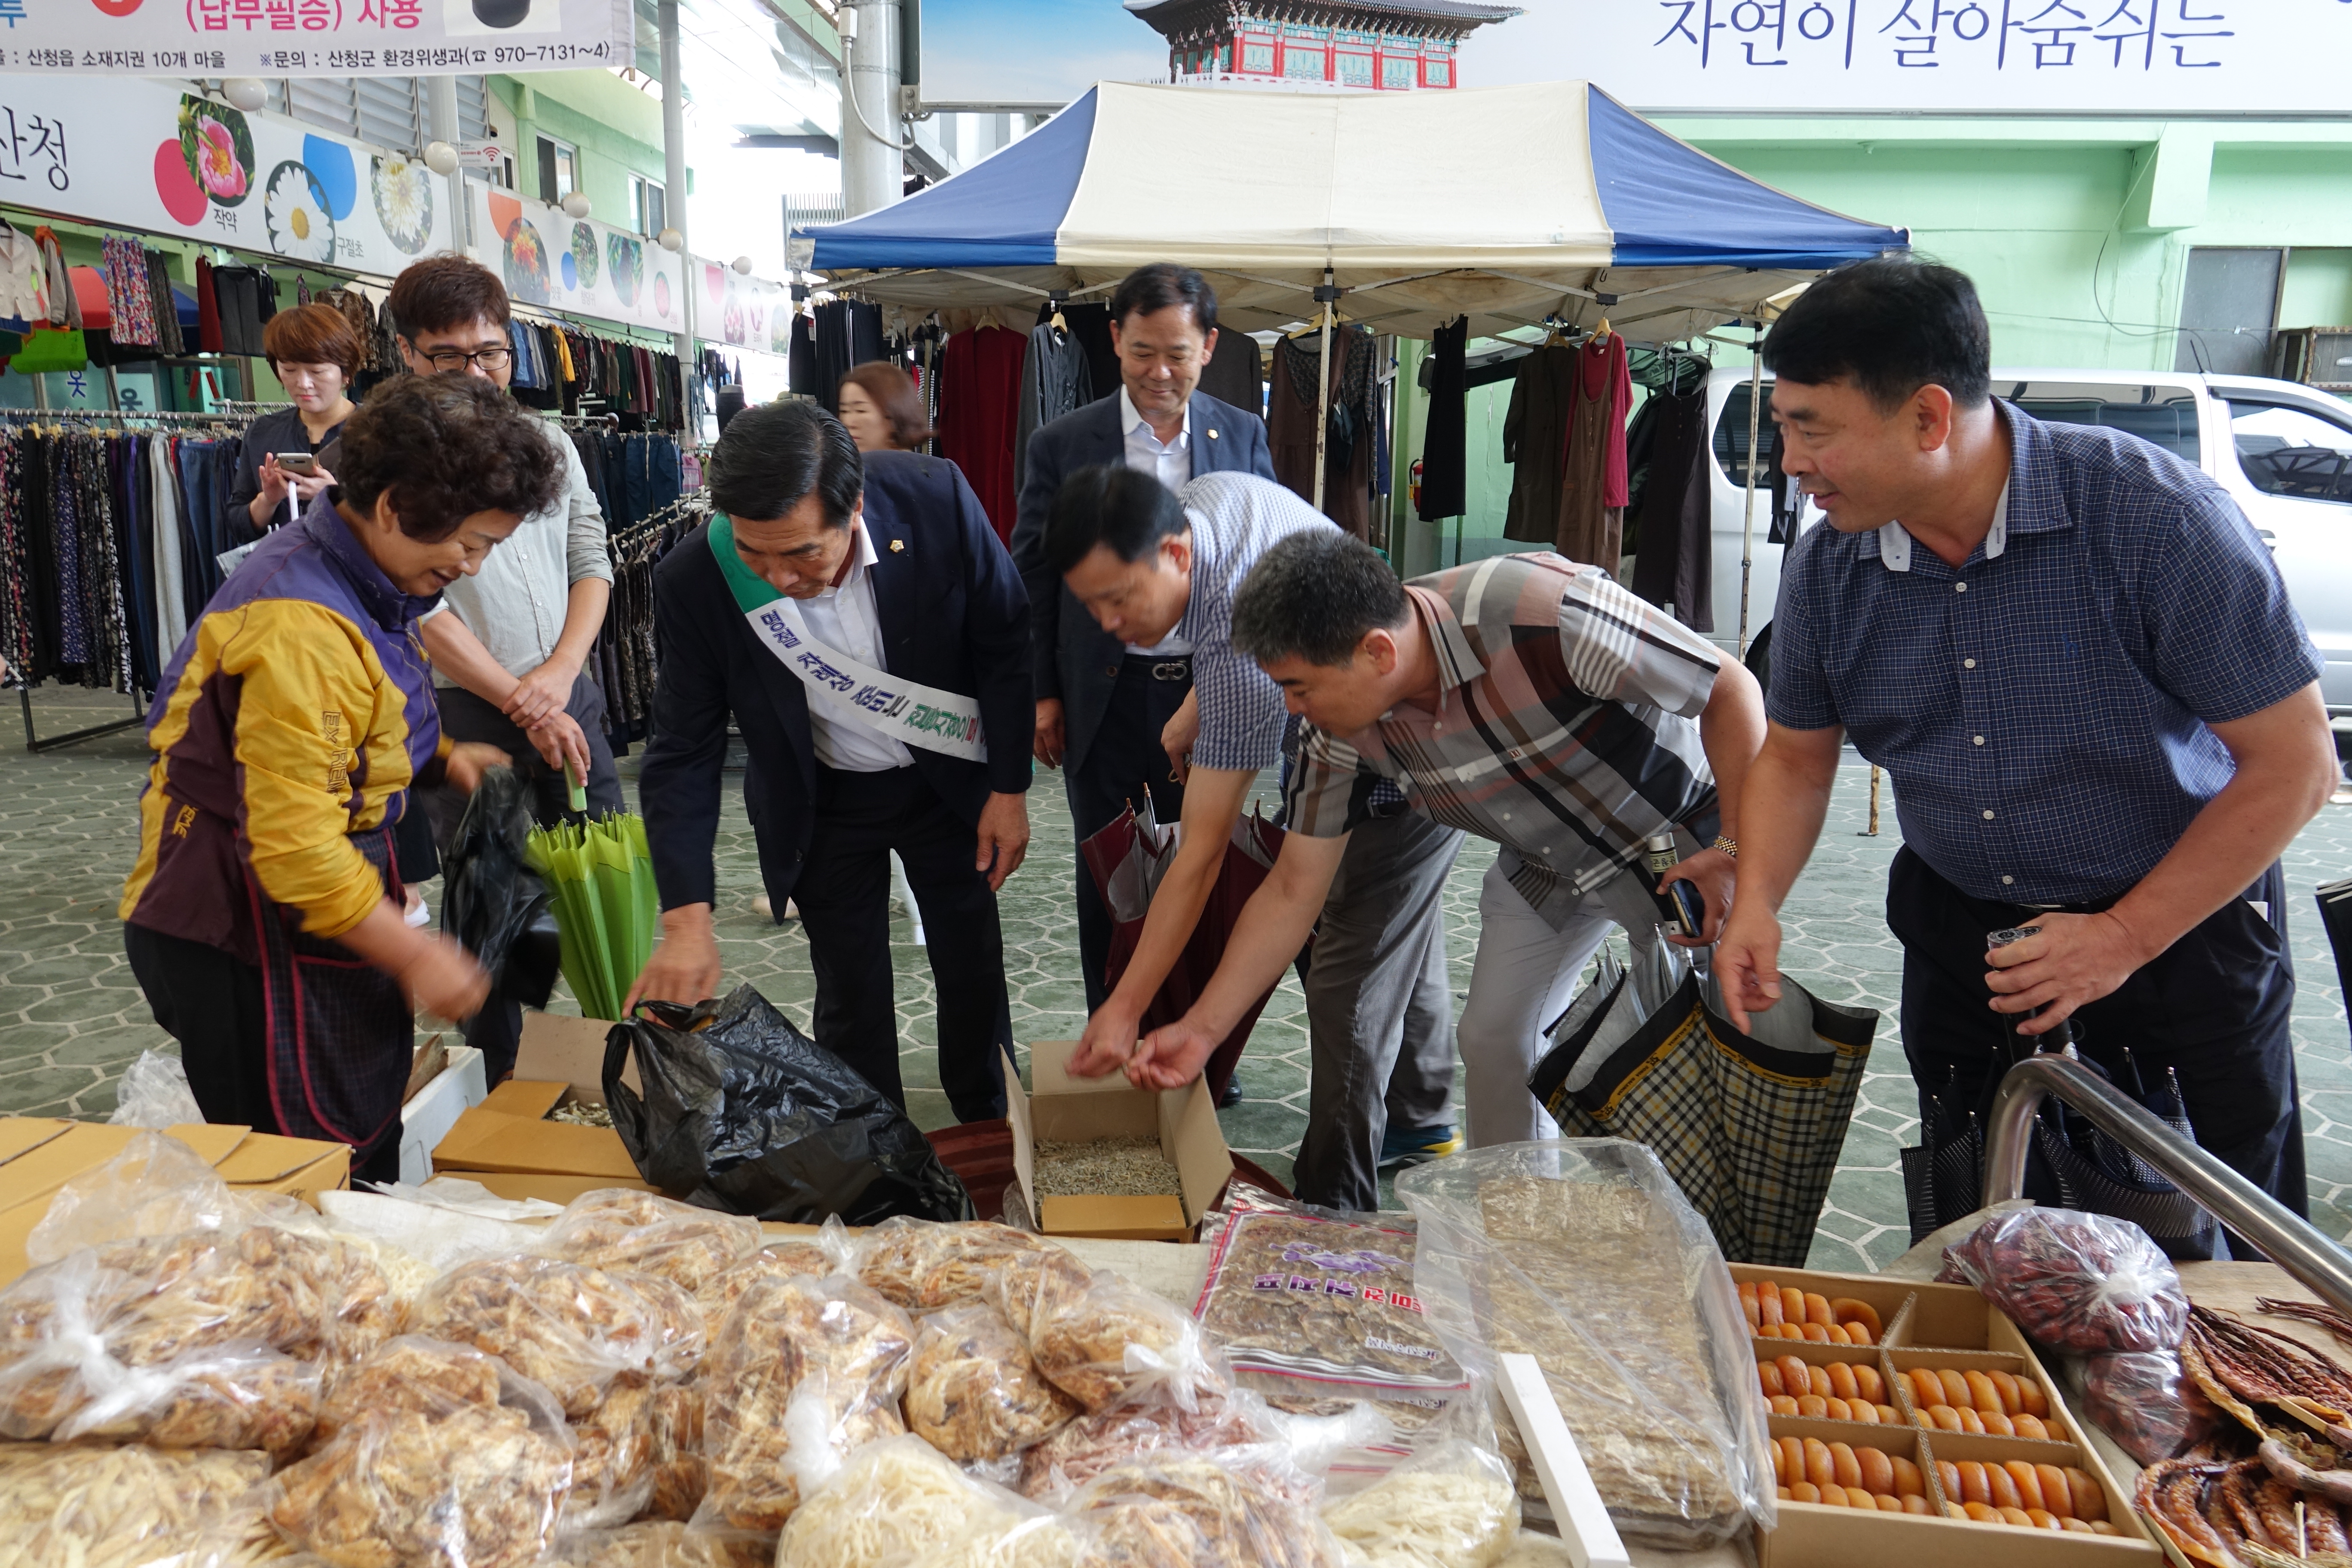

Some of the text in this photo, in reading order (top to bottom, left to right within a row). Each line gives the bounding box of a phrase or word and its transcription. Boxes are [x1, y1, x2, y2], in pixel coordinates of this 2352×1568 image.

[1654, 0, 1856, 70] 자연이
[27, 48, 74, 67] 산청읍
[82, 50, 145, 68] 소재지권
[153, 51, 187, 68] 10개
[194, 51, 225, 68] 마을
[328, 49, 376, 67] 산청군
[214, 208, 237, 233] 작약
[337, 236, 364, 257] 구절초
[760, 609, 802, 649] 명절
[796, 651, 856, 692] 차례상
[849, 684, 911, 718] 준비는
